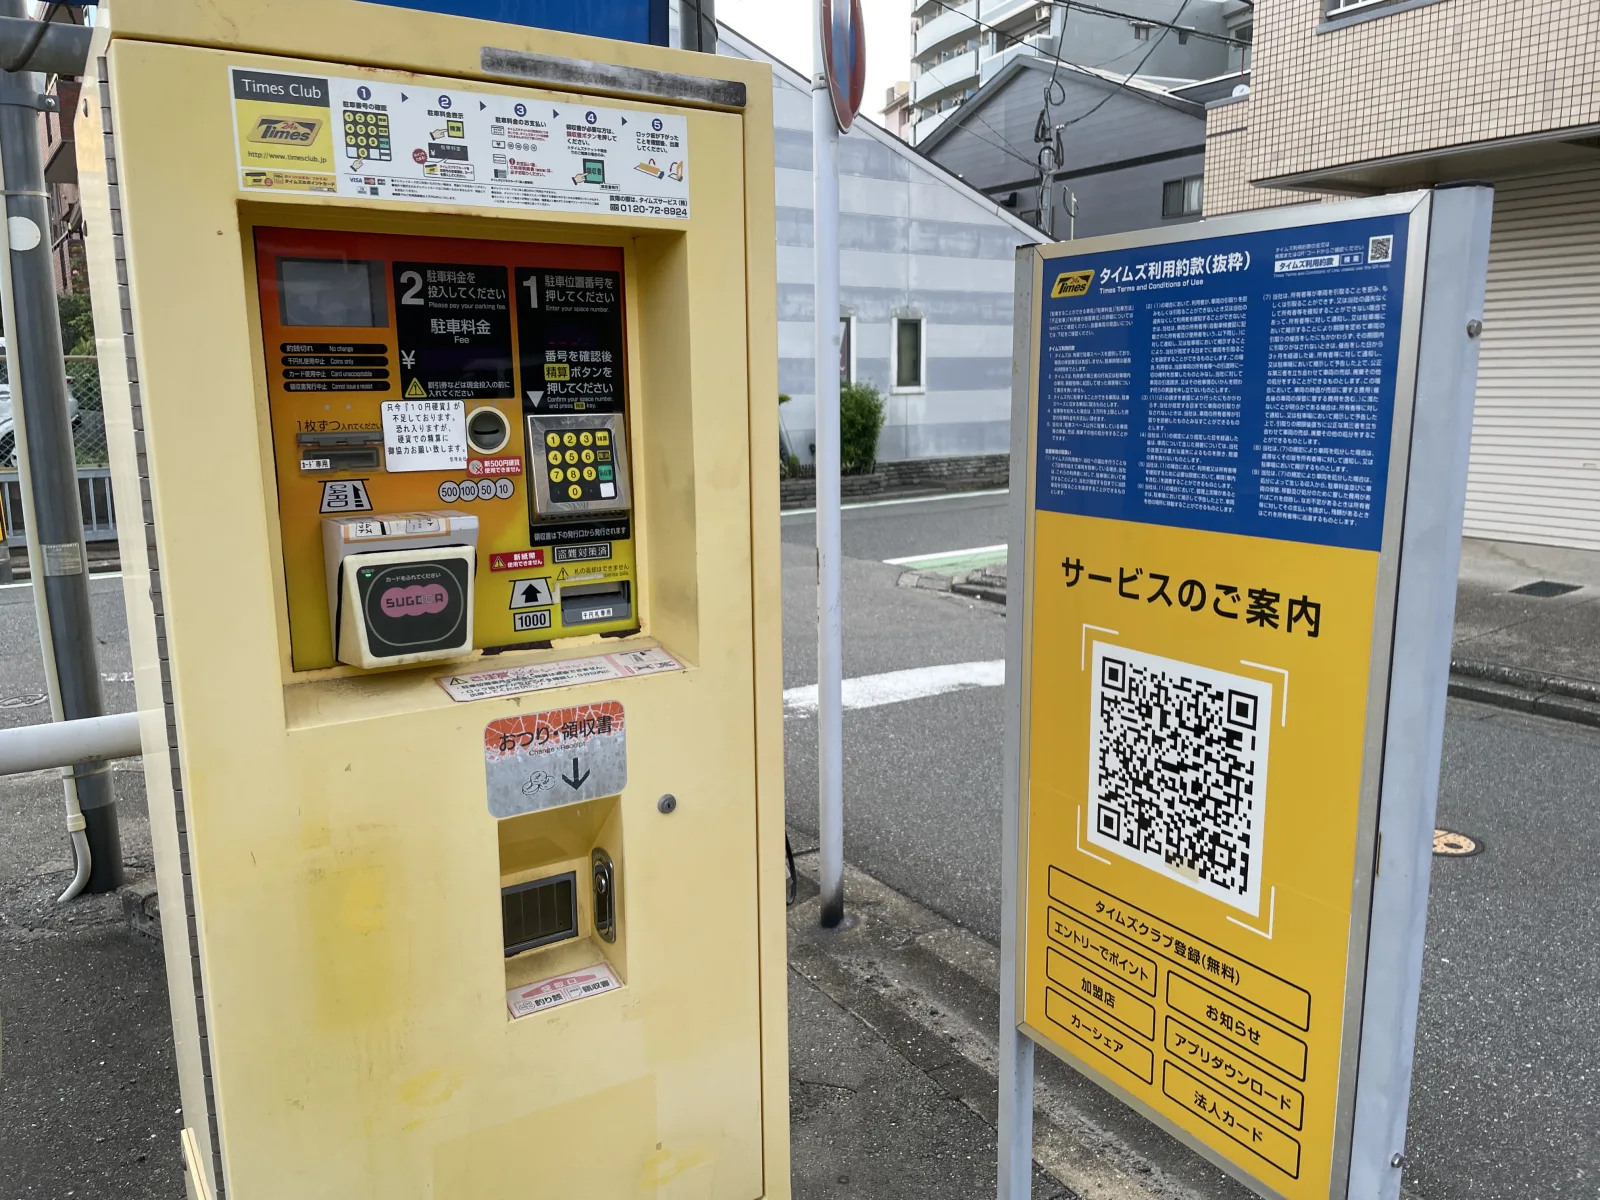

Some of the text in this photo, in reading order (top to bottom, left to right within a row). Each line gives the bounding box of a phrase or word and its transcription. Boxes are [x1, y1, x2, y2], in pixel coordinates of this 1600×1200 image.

[241, 78, 321, 98] Times Club
[427, 109, 464, 119] 駐車料金表示
[495, 117, 547, 127] 駐車料金のお支払い
[260, 125, 311, 141] Times
[566, 124, 615, 135] 領収書が必要な方は、
[566, 132, 617, 142] 領収書ボタンを押して
[567, 138, 590, 146] ください。
[636, 132, 679, 141] ロック板が下がった
[636, 139, 679, 148] ことを確認後、出庫
[636, 144, 668, 153] してください。
[247, 150, 327, 163] http://www.timesclub.jp
[609, 195, 688, 206] 故障の際は、タイムズサービス(株)
[620, 204, 688, 216] 0120-72-8924
[1100, 251, 1251, 284] タイムズ利用約款(抜粋)
[427, 270, 475, 284] 駐車料金を
[545, 275, 613, 289] 駐車位置番号を
[400, 271, 424, 305] 2
[523, 276, 538, 308] 1
[1058, 282, 1087, 295] Times
[1117, 285, 1135, 293] Terms
[1149, 280, 1181, 290] Conditions
[1191, 278, 1203, 286] Use
[428, 286, 506, 299] 投入してください
[546, 290, 614, 303] 押してください
[430, 319, 491, 335] 駐車料金
[454, 336, 469, 344] Fee
[401, 350, 415, 369] ¥
[545, 350, 613, 362] 番号を確認後
[545, 366, 612, 378] 精算 ボタンを
[428, 381, 511, 389] 割引券などは現金投入の前に
[547, 382, 613, 394] 押してください
[392, 413, 456, 422] 不足しております。
[396, 424, 452, 433] 恐れ入りますが、
[397, 434, 449, 444] 硬貨での精算に
[388, 446, 466, 455] 御協力お願い致します。
[484, 466, 520, 474] 使用できません
[327, 483, 348, 508] CARD
[441, 484, 508, 497] 500 100 50 10
[557, 546, 608, 559] 盗難対策済
[507, 559, 542, 568] 使用できません
[386, 573, 441, 583] カードをふれてください
[1061, 557, 1322, 638] サービスのご案内
[518, 613, 546, 628] 1000
[499, 715, 612, 752] おつり・領収書
[528, 746, 555, 757] Change
[1094, 900, 1241, 986] タイムズクラブ登録(無料)
[1054, 922, 1149, 981] エントリーでポイント
[581, 979, 611, 993] 領収書
[1081, 976, 1116, 1009] 加盟店
[1205, 1004, 1261, 1046] お知らせ
[1070, 1013, 1124, 1054] カーシェア
[1174, 1031, 1292, 1110] アプリダウンロード
[1193, 1090, 1263, 1143] 法人カード
